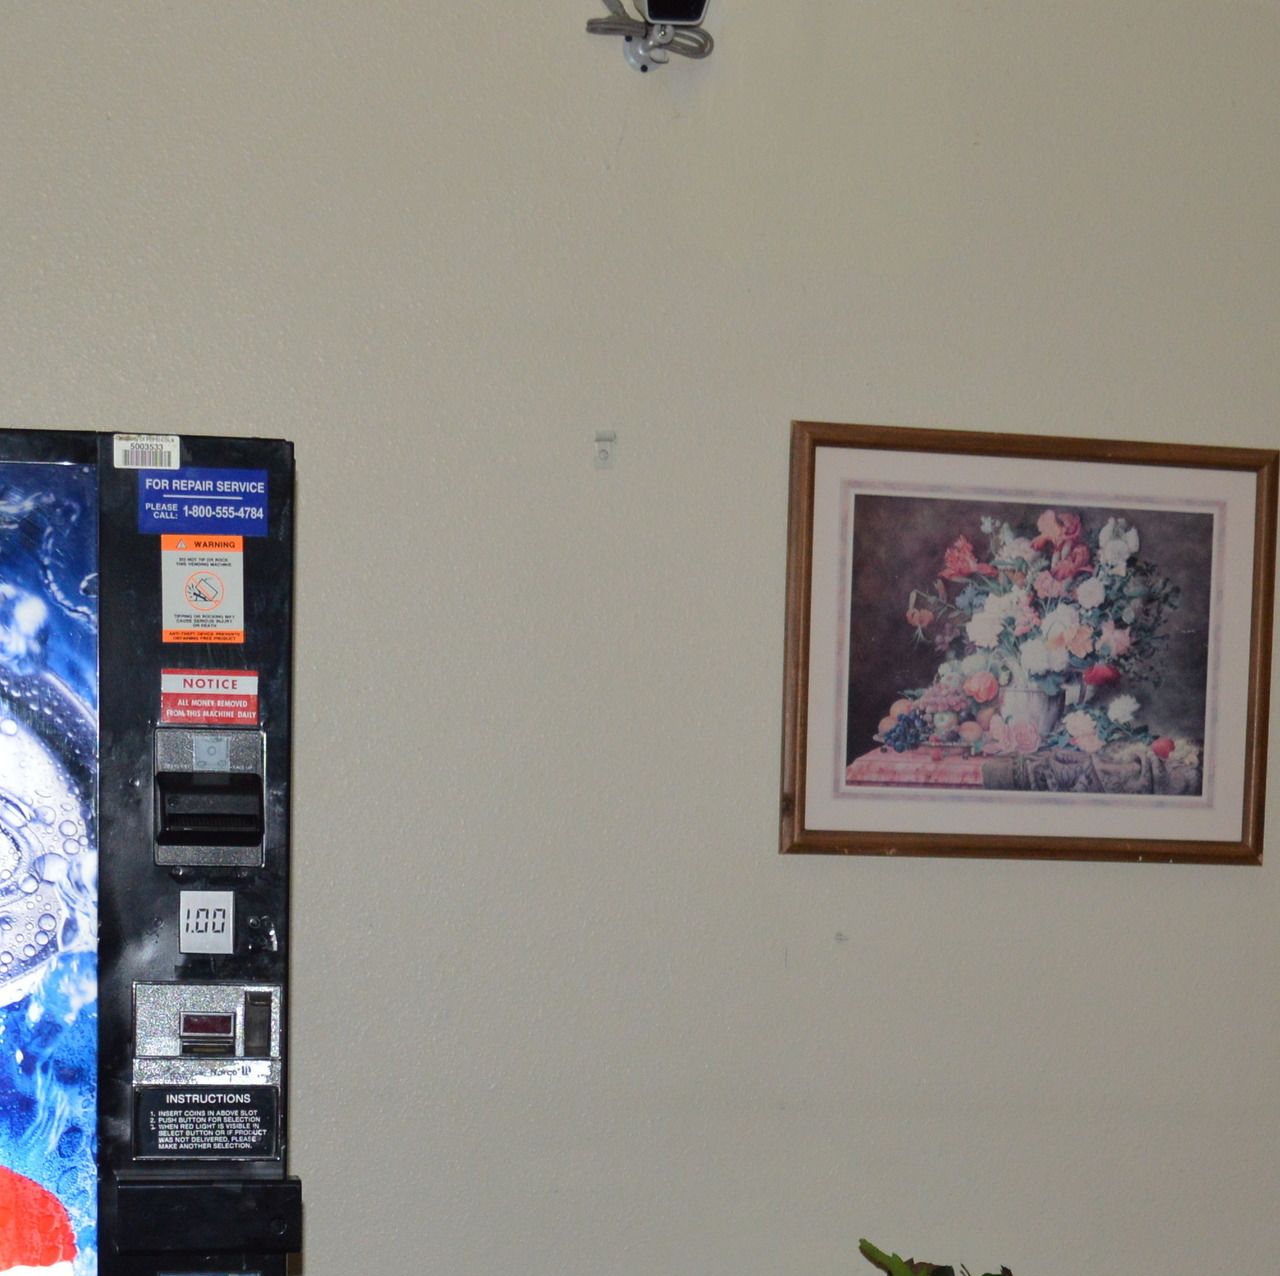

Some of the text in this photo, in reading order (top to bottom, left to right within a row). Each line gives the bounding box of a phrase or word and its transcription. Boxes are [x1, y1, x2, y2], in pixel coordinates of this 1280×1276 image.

[146, 478, 264, 493] FOR REPAIR SERVICE
[145, 503, 178, 511] PLEASE
[183, 505, 264, 520] 1-800-555-4784
[183, 678, 238, 690] NOTICE
[191, 699, 215, 707] MONEY
[217, 700, 248, 708] REMOVED
[187, 710, 200, 718] THIS
[202, 710, 234, 718] MACHINE
[185, 908, 226, 933] 1.00
[166, 1094, 251, 1104] INSTRUCTIONS
